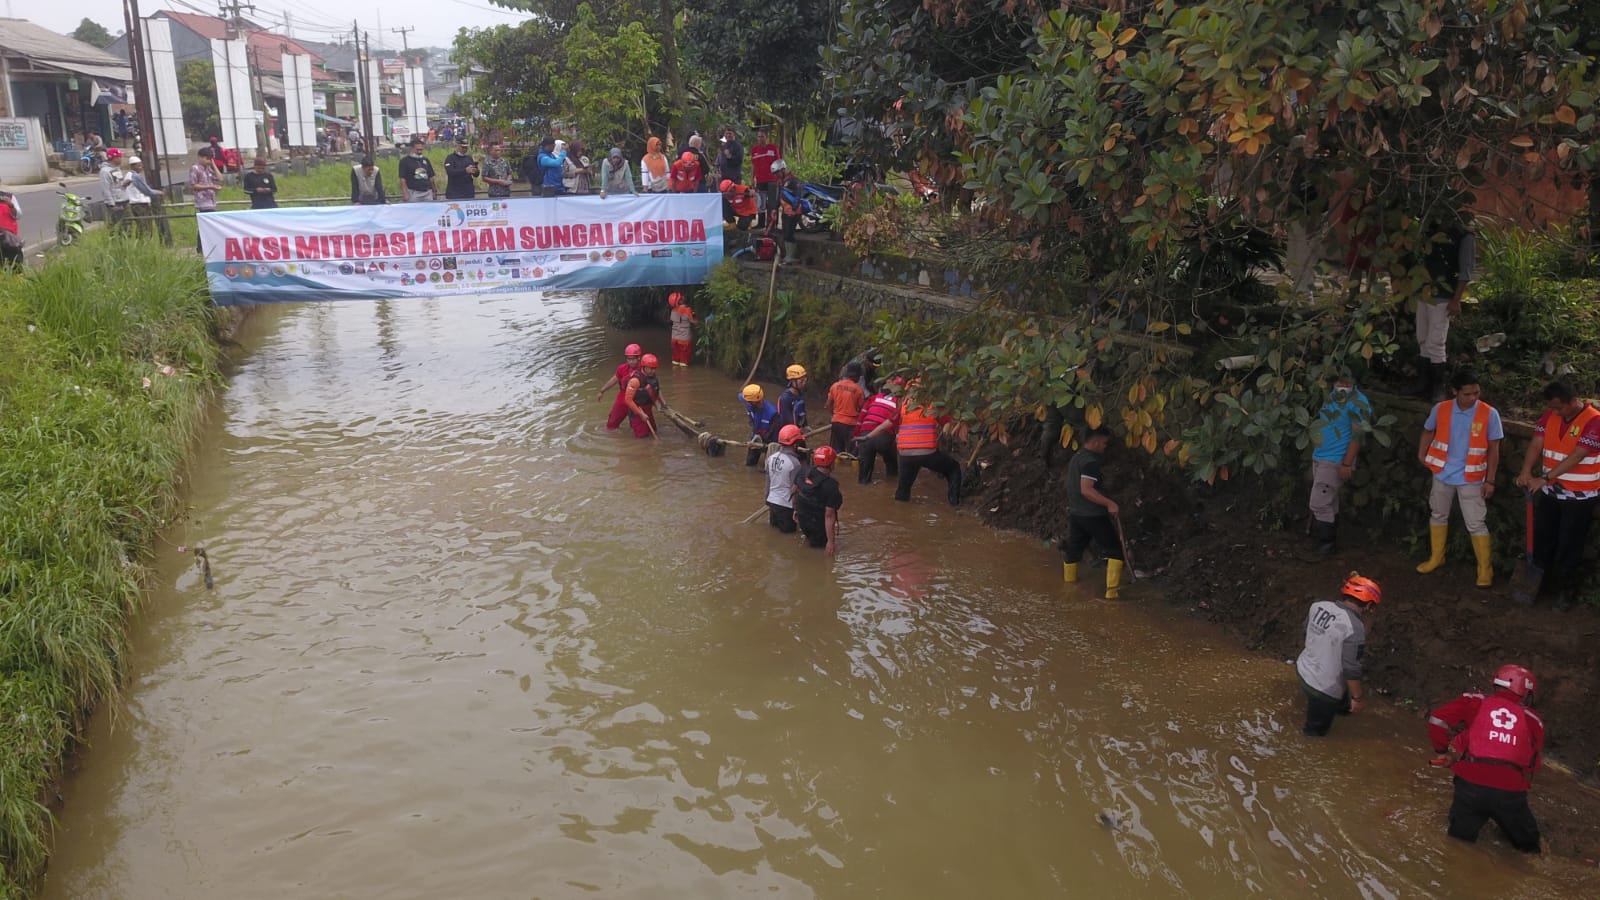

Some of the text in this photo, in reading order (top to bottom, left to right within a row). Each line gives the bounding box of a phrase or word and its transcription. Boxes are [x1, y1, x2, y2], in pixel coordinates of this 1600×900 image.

[466, 209, 488, 217] PRB
[225, 218, 706, 261] AKSI MITIGASI ALIRAN SUNGAI CISUDA
[1313, 607, 1337, 630] TRC
[1489, 730, 1517, 746] PMI
